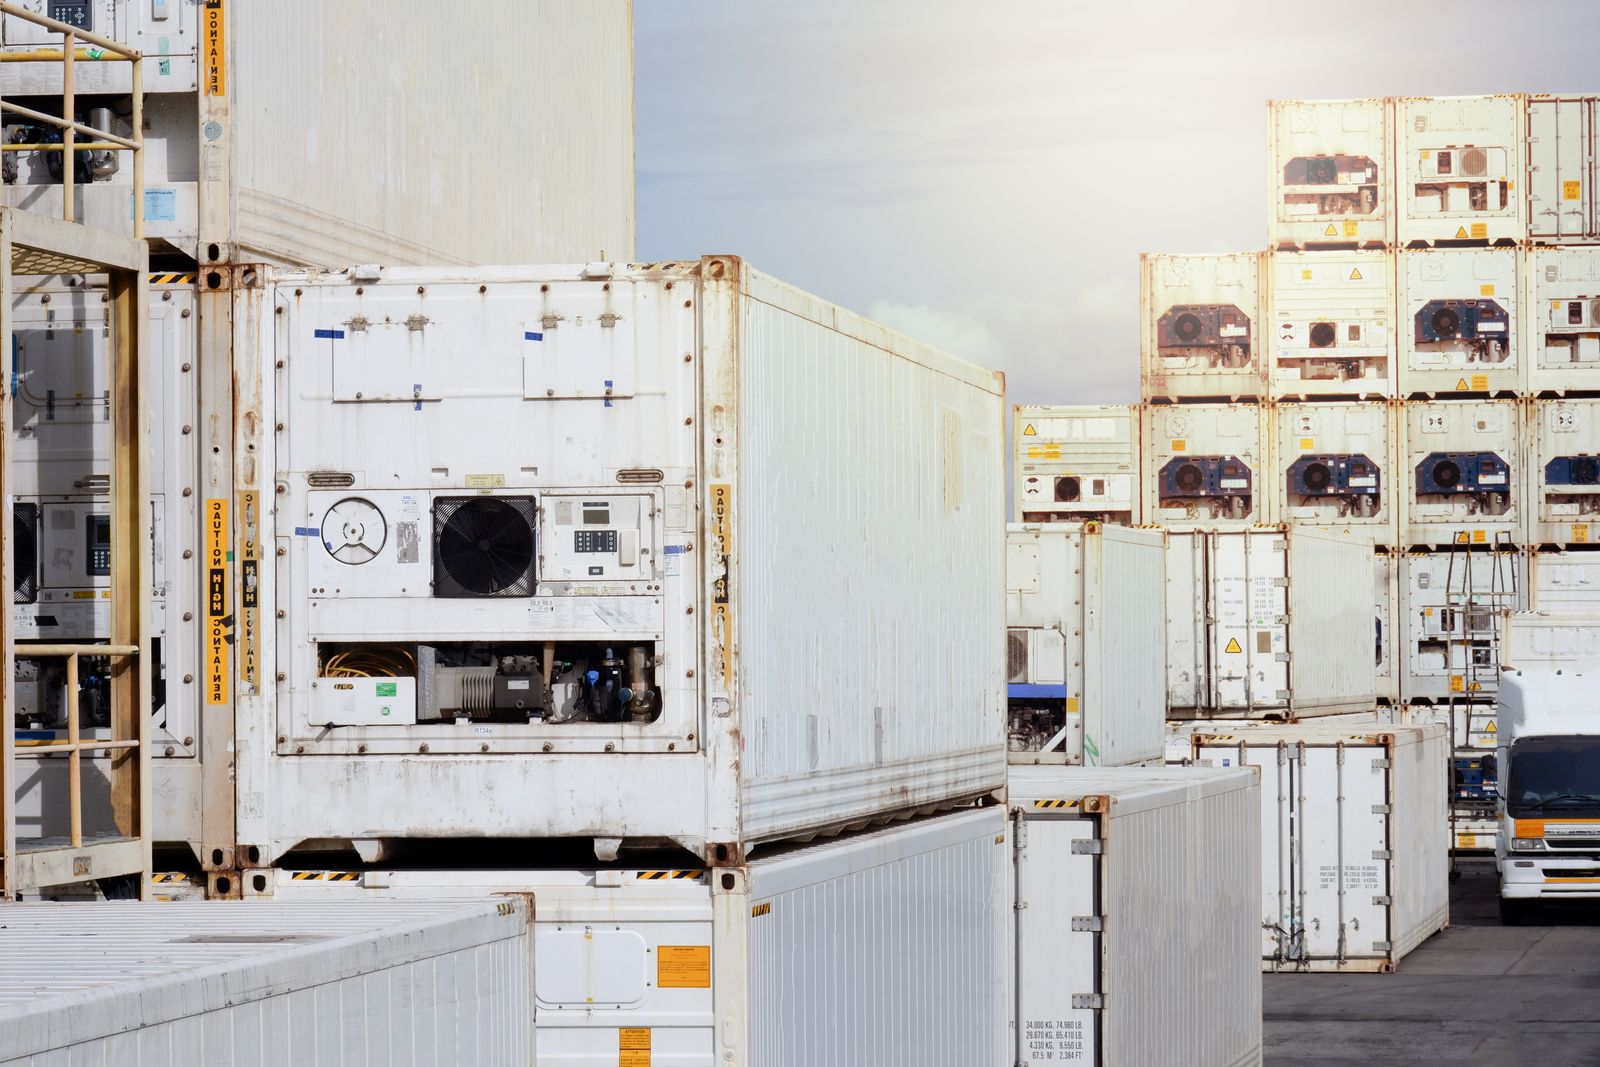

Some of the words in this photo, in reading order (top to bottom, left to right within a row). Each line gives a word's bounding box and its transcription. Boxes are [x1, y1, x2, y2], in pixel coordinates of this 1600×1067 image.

[1026, 1021, 1044, 1029] 34.000
[1045, 1021, 1054, 1029] KG.
[1056, 1021, 1074, 1029] 74.960
[1075, 1021, 1083, 1029] LB.
[1026, 1031, 1044, 1039] 29.670
[1045, 1031, 1054, 1039] KG.
[1056, 1031, 1074, 1039] 65.410
[1075, 1031, 1083, 1039] LB.
[1029, 1041, 1044, 1049] 4.330
[1045, 1041, 1054, 1049] KG.
[1059, 1041, 1074, 1049] 9.550
[1075, 1041, 1083, 1049] LB.
[1032, 1051, 1044, 1060] 67.5
[1059, 1051, 1074, 1060] 2.384
